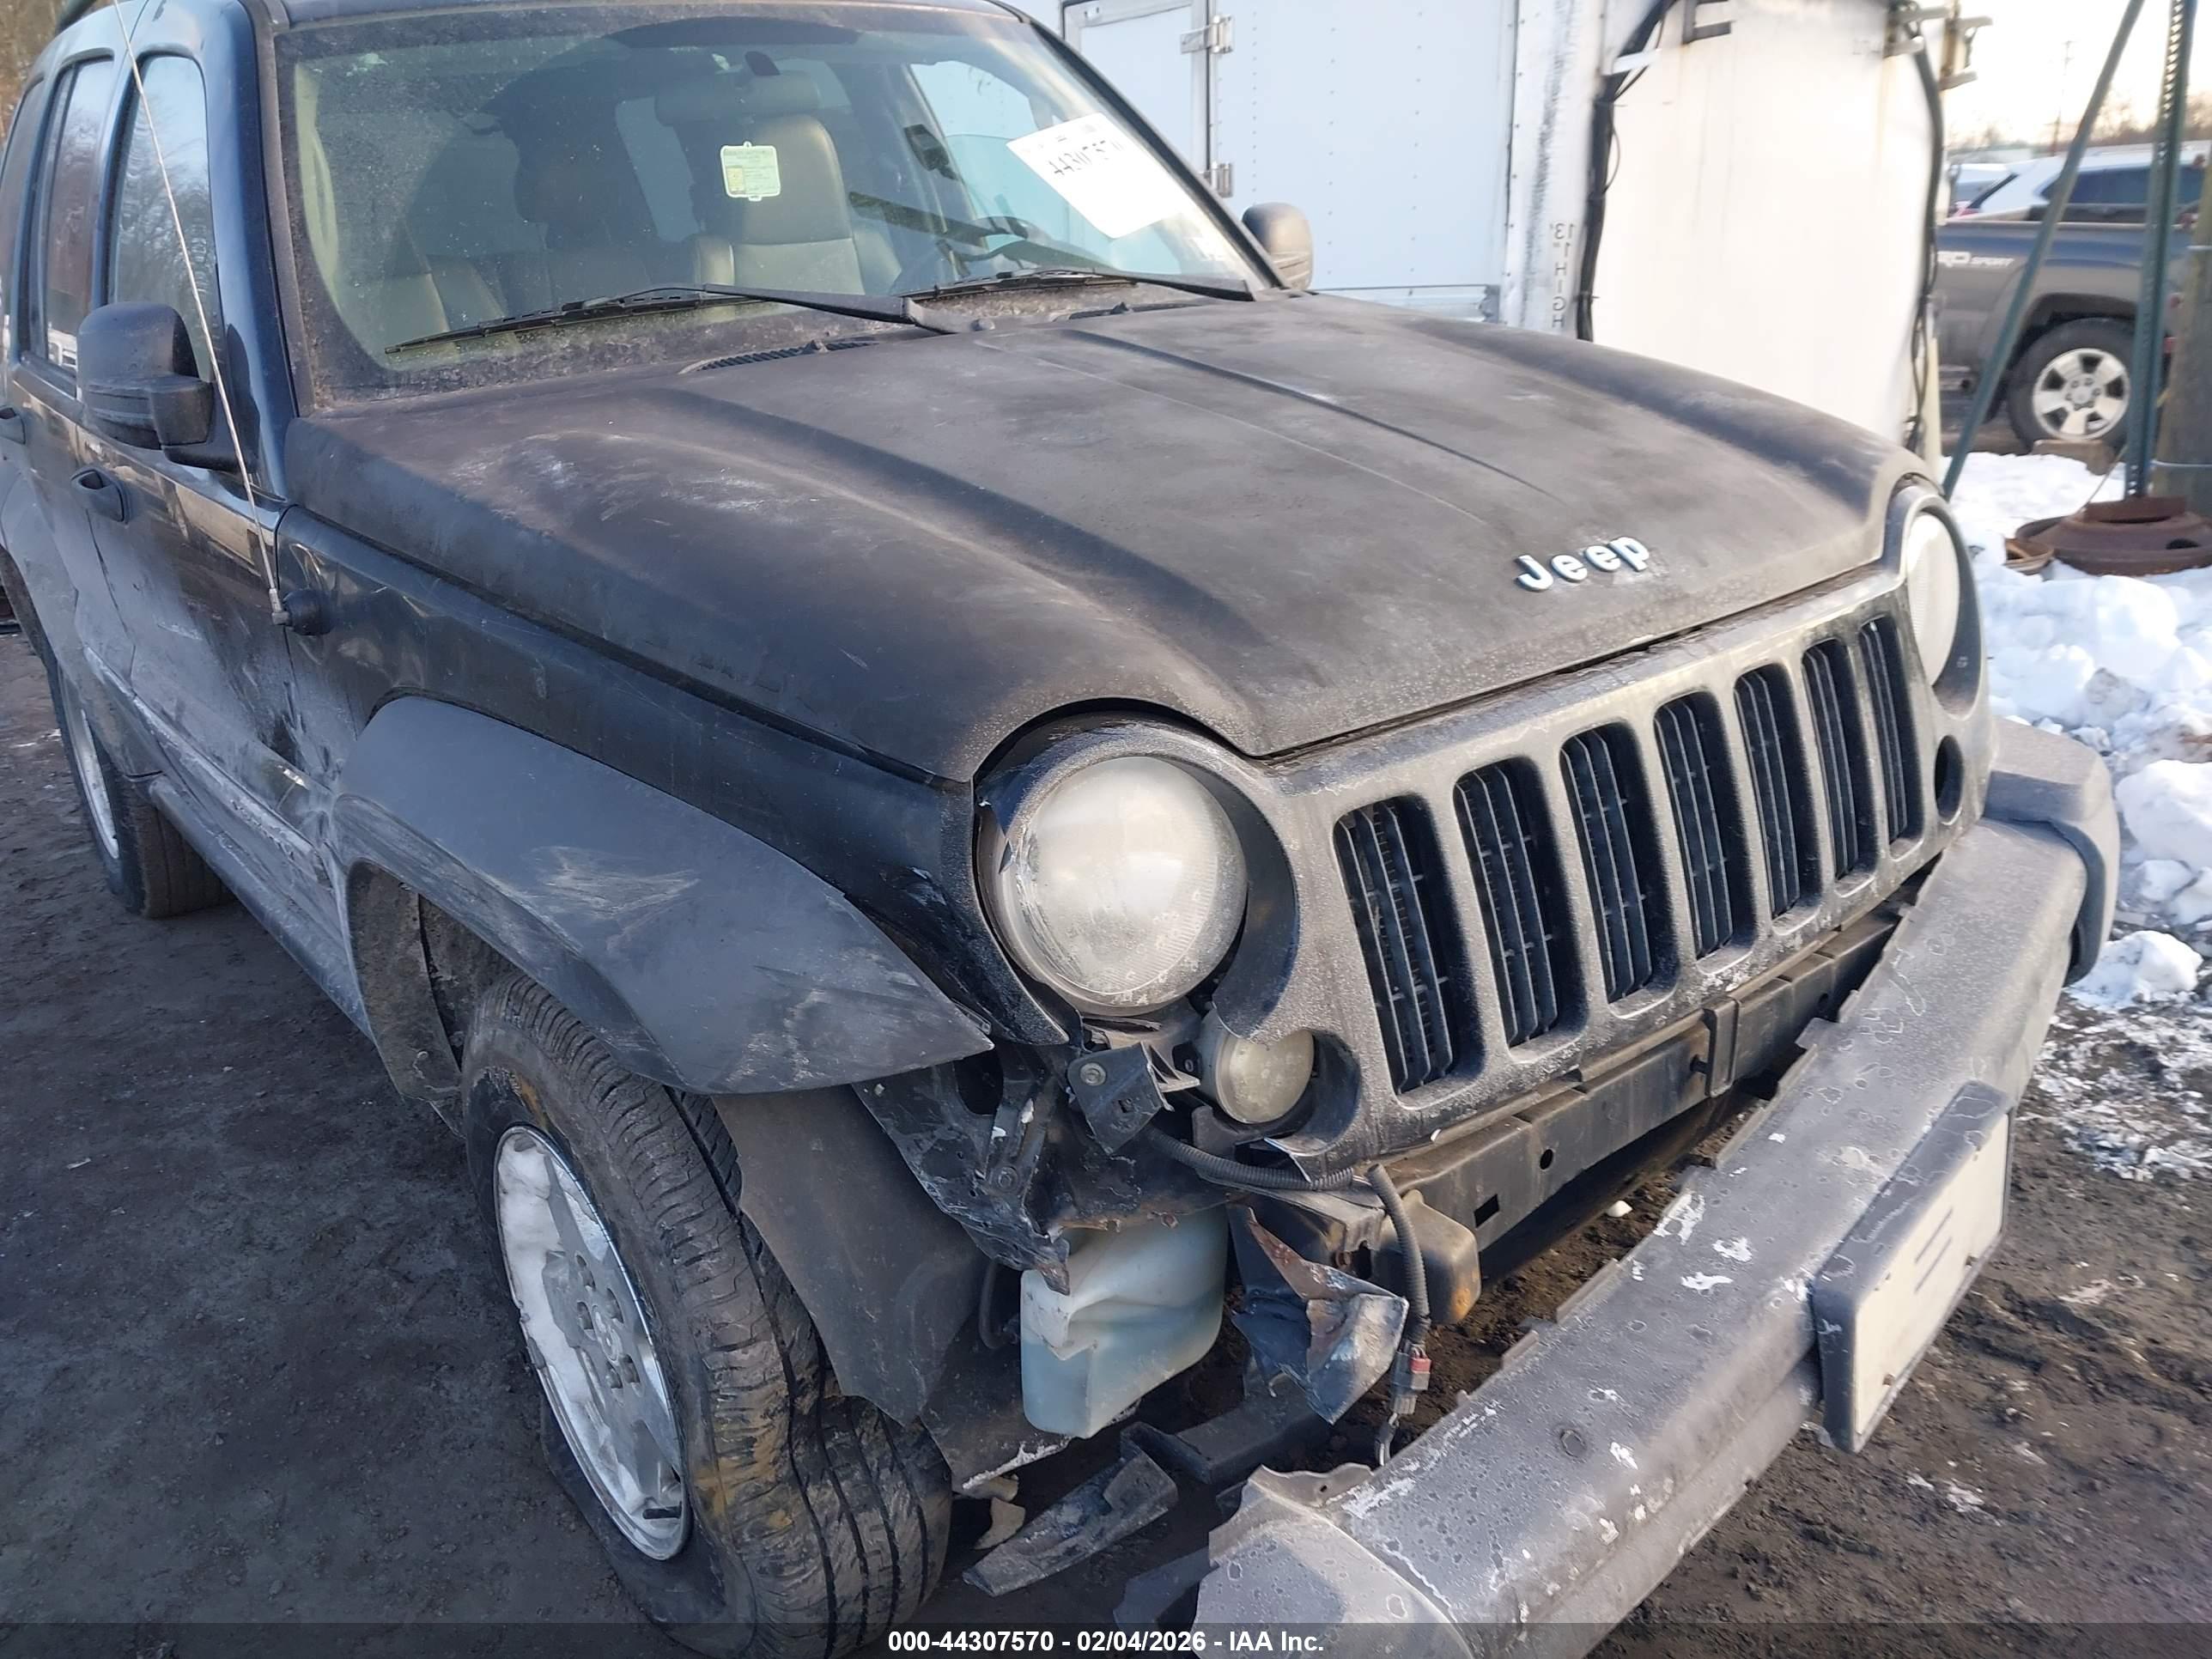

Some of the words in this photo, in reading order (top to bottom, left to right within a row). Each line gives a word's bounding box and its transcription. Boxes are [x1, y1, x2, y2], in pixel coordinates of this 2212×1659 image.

[1936, 251, 1971, 268] RD
[1972, 257, 2014, 268] SPORT
[1516, 536, 1650, 592] Jeep
